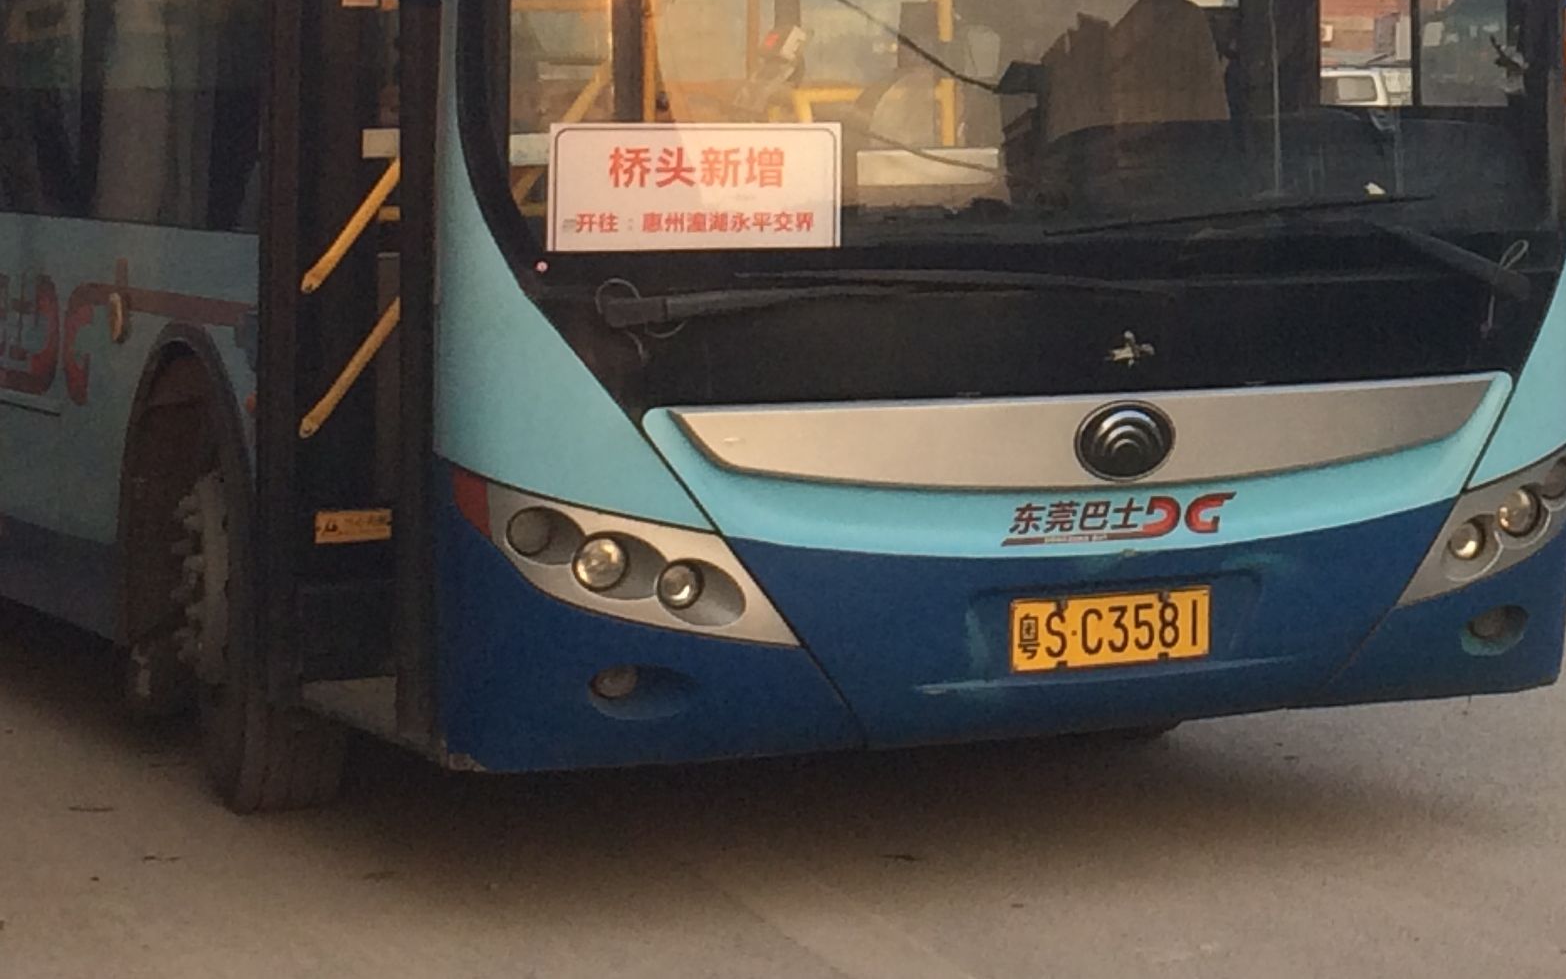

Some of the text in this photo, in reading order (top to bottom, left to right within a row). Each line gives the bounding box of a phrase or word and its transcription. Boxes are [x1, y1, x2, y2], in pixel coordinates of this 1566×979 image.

[609, 145, 786, 189] 桥头新增
[1008, 491, 1238, 537] 东莞巴士 DG
